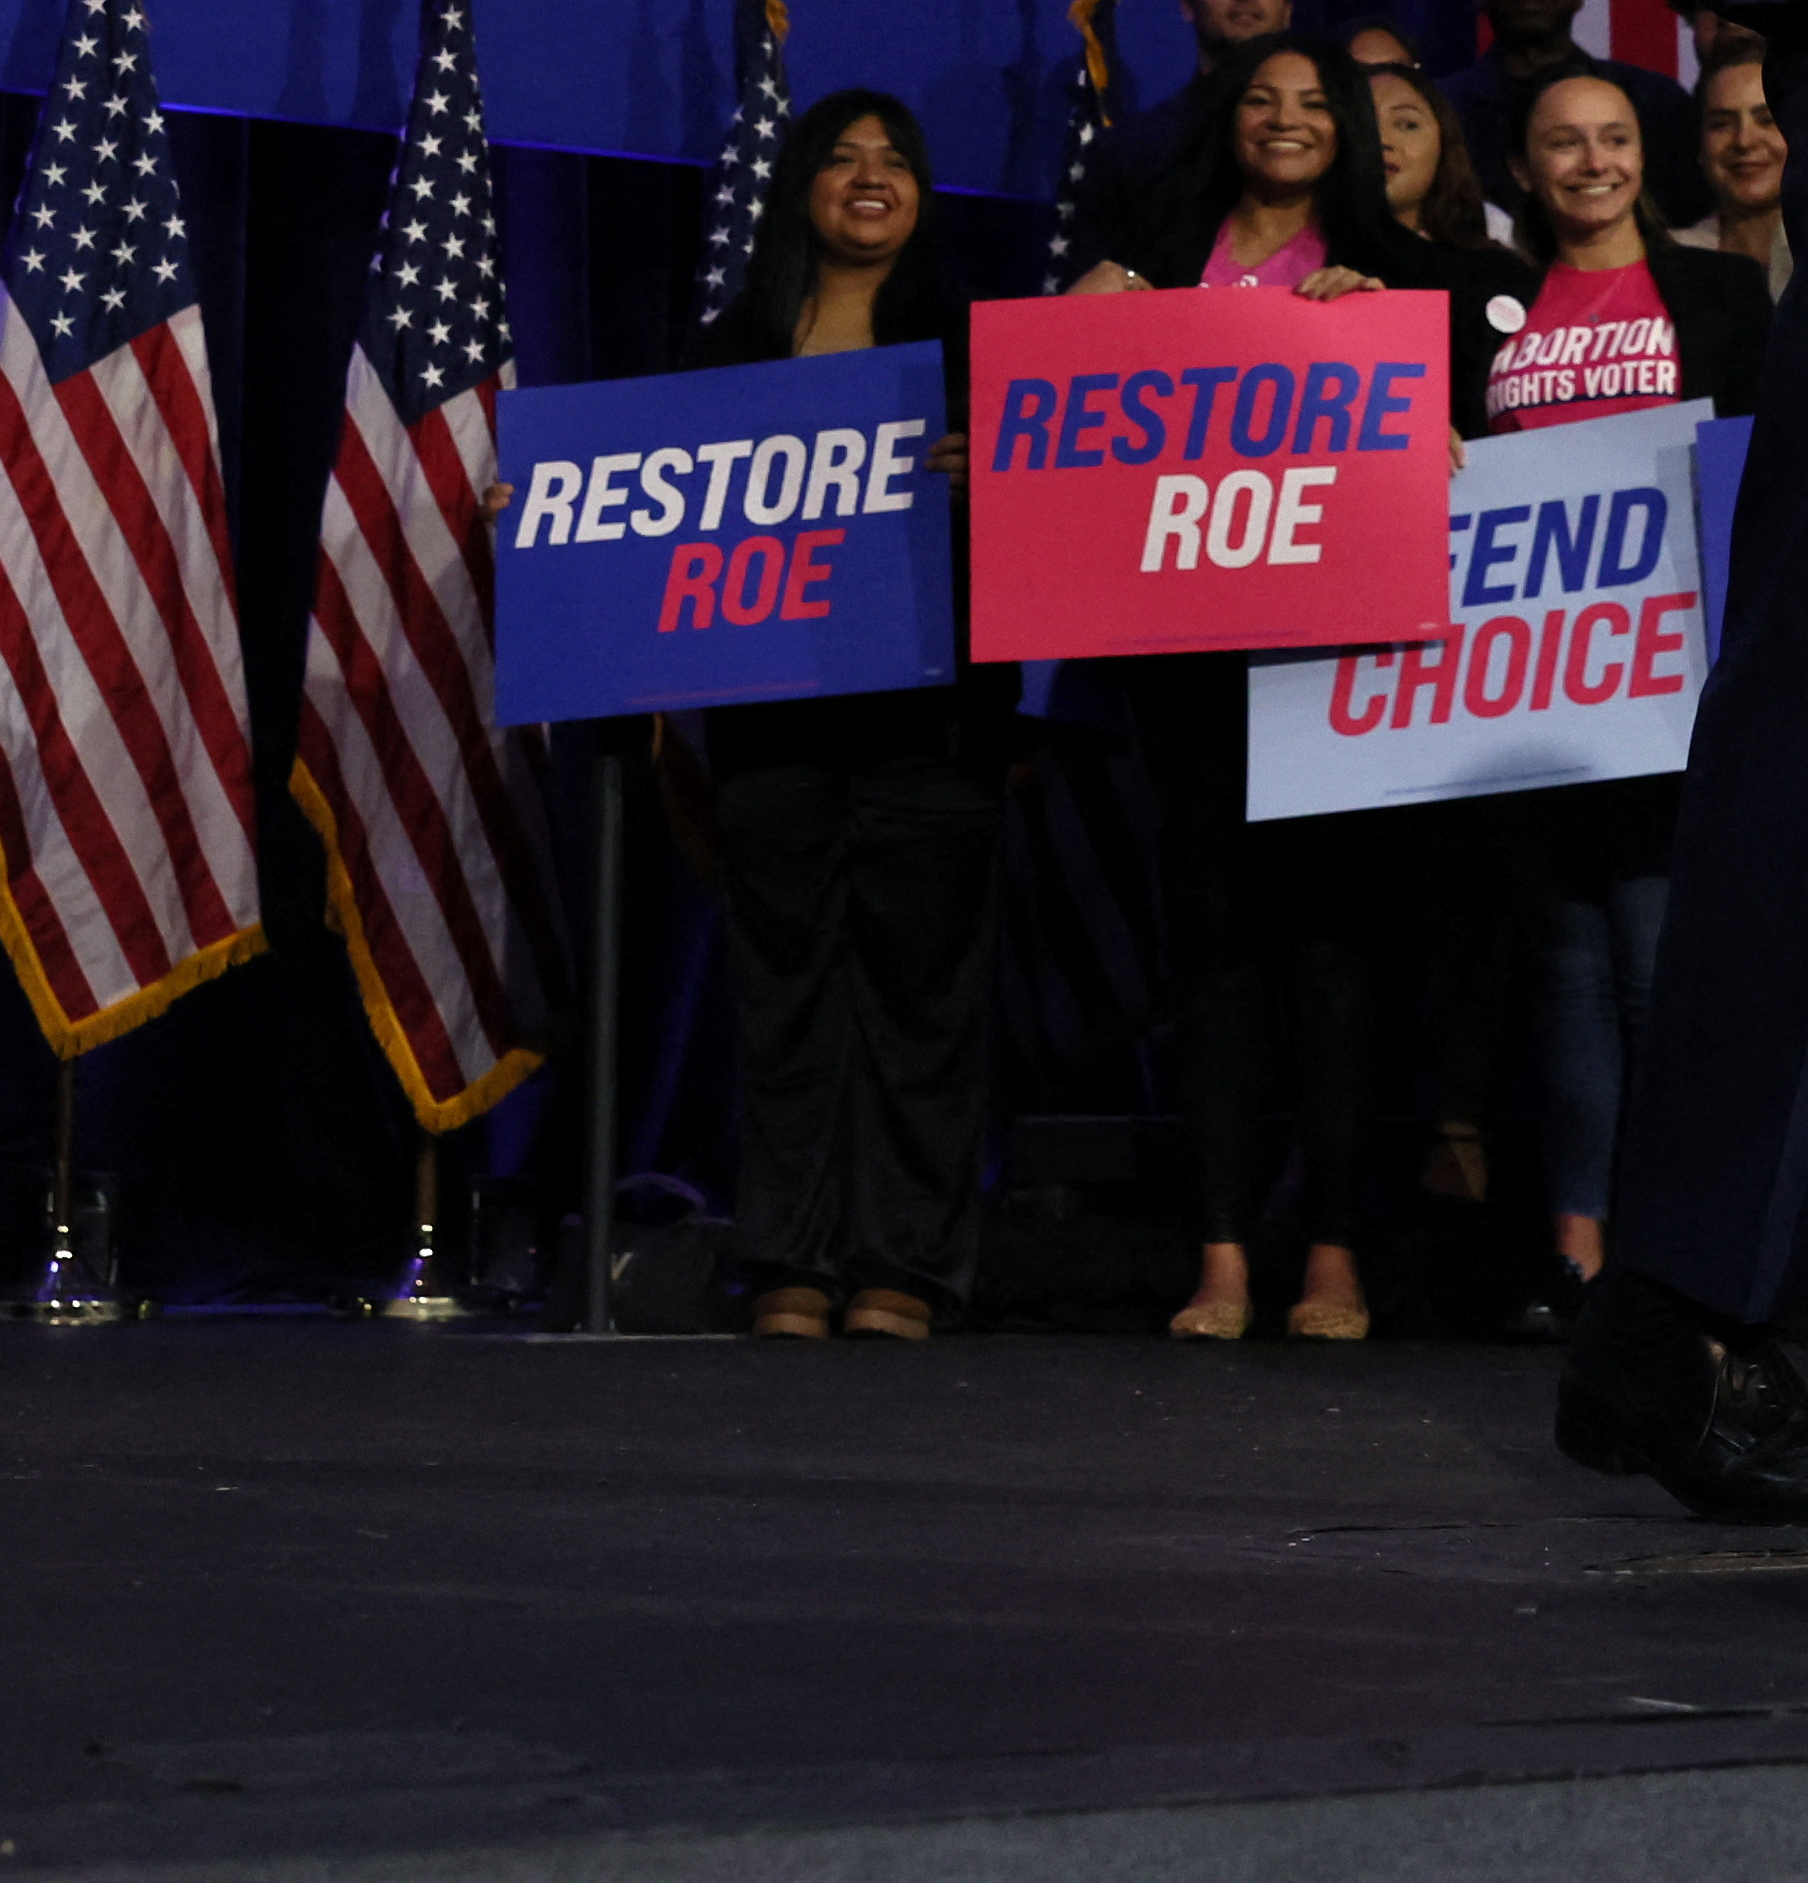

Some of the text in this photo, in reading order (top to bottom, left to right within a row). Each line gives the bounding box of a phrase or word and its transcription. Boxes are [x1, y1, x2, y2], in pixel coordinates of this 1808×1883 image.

[1490, 316, 1677, 376] ABORTION
[1583, 359, 1677, 399] VOTER
[991, 361, 1427, 472] RESTORE
[514, 418, 927, 550] RESTORE
[1139, 465, 1338, 572] ROE
[657, 527, 847, 634] ROE
[1328, 590, 1698, 737] CHOICE
